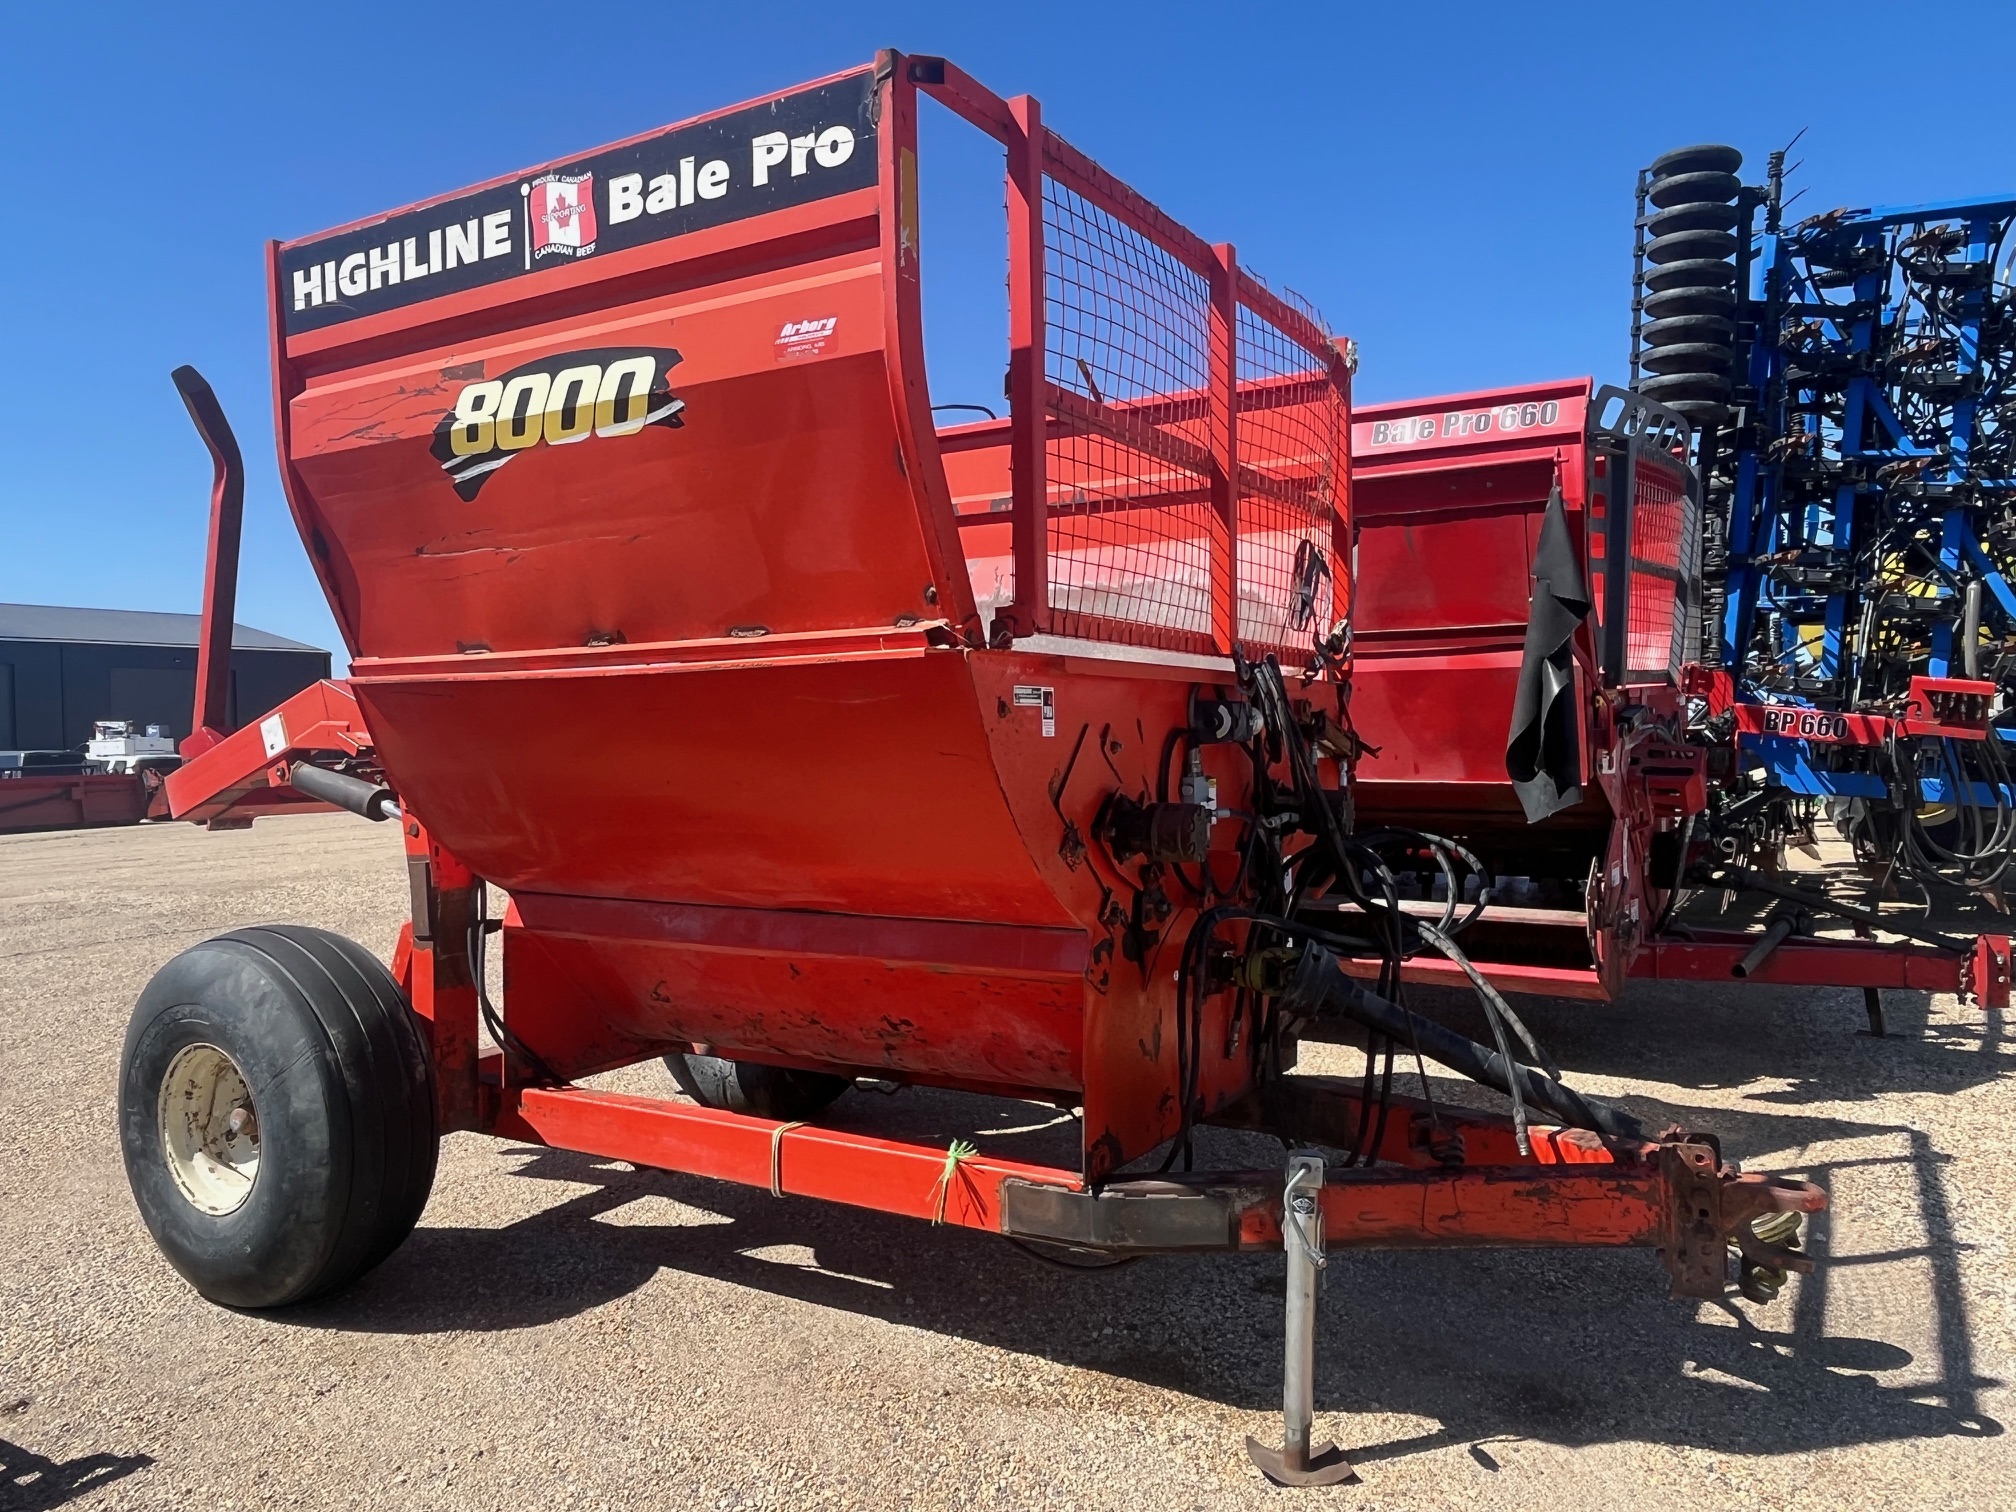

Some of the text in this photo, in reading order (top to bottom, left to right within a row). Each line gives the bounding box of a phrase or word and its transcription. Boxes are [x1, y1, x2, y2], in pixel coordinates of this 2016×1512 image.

[561, 170, 592, 184] CANADIAN
[292, 125, 855, 312] HIGHLINE Bale Pro
[541, 204, 587, 223] SUPPORTING
[534, 242, 597, 260] CANADIAN BEEF
[450, 355, 657, 457] 8000
[1371, 400, 1559, 446] Bale Pro 660
[1763, 709, 1849, 740] BP 660
